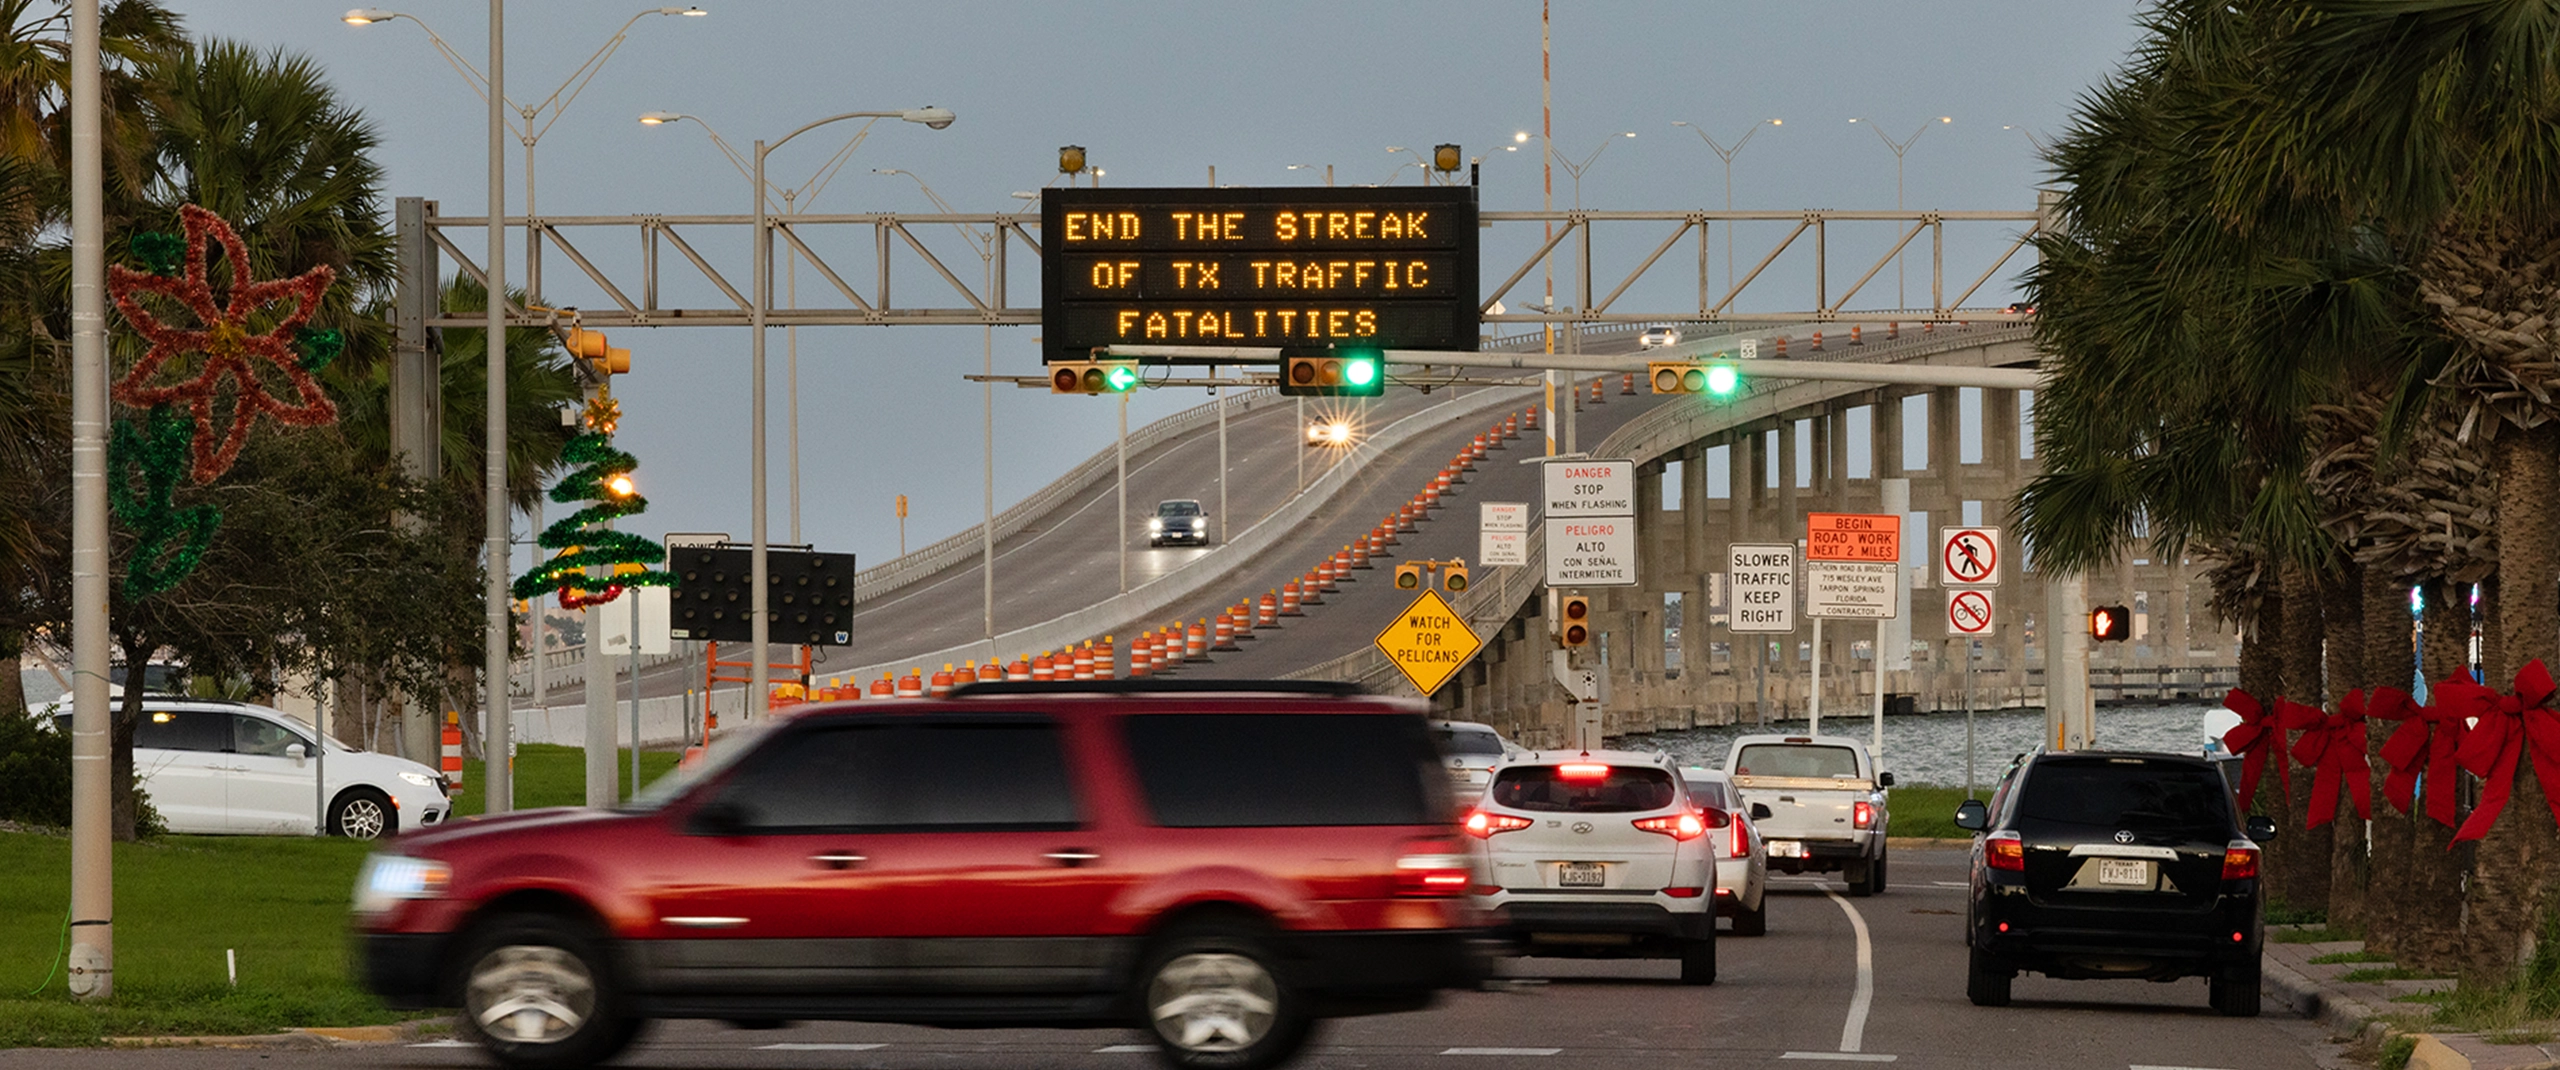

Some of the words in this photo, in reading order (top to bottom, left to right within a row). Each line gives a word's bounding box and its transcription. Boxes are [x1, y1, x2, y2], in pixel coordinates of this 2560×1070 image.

[1066, 212, 1140, 241] END
[1172, 212, 1245, 241] THE
[1276, 211, 1428, 240] STREAK
[1093, 261, 1140, 290] OF
[1172, 261, 1219, 290] TX
[1250, 260, 1428, 290] TRAFFIC
[1119, 310, 1377, 339] FATALITIES
[1565, 467, 1612, 478] DANGER
[1573, 484, 1604, 495] STOP
[1551, 501, 1577, 510] WHEN
[1581, 499, 1627, 510] FLASHING
[1565, 525, 1615, 536] PELIGRO
[1835, 518, 1873, 530] BEGIN
[1813, 532, 1848, 544] ROAD
[1858, 533, 1892, 545] WORK
[1576, 542, 1606, 553] ALTO
[1813, 545, 1840, 556] NEXT
[1846, 545, 1855, 557] 2
[1861, 546, 1893, 558] MILES
[1563, 558, 1583, 567] CON
[1587, 554, 1618, 567] SEÑAL
[1734, 553, 1790, 568] SLOWER
[1559, 569, 1623, 579] INTERMITENTE
[1839, 565, 1856, 573] ROAD
[1857, 565, 1863, 573] &
[1733, 572, 1791, 586] TRAFFIC
[1822, 574, 1836, 583] 715
[1836, 575, 1866, 584] WESLEY
[1867, 576, 1883, 584] AVE
[1819, 584, 1849, 593] TARPON
[1853, 585, 1886, 594] SPRINGS
[1744, 591, 1781, 604] KEEP
[1835, 595, 1868, 603] FLORIDA
[1740, 609, 1784, 622] RIGHT
[1826, 606, 1877, 616] CONTRACTOR
[1409, 615, 1451, 630] WATCH
[1416, 632, 1442, 646] FOR
[1397, 649, 1460, 664] PELICANS
